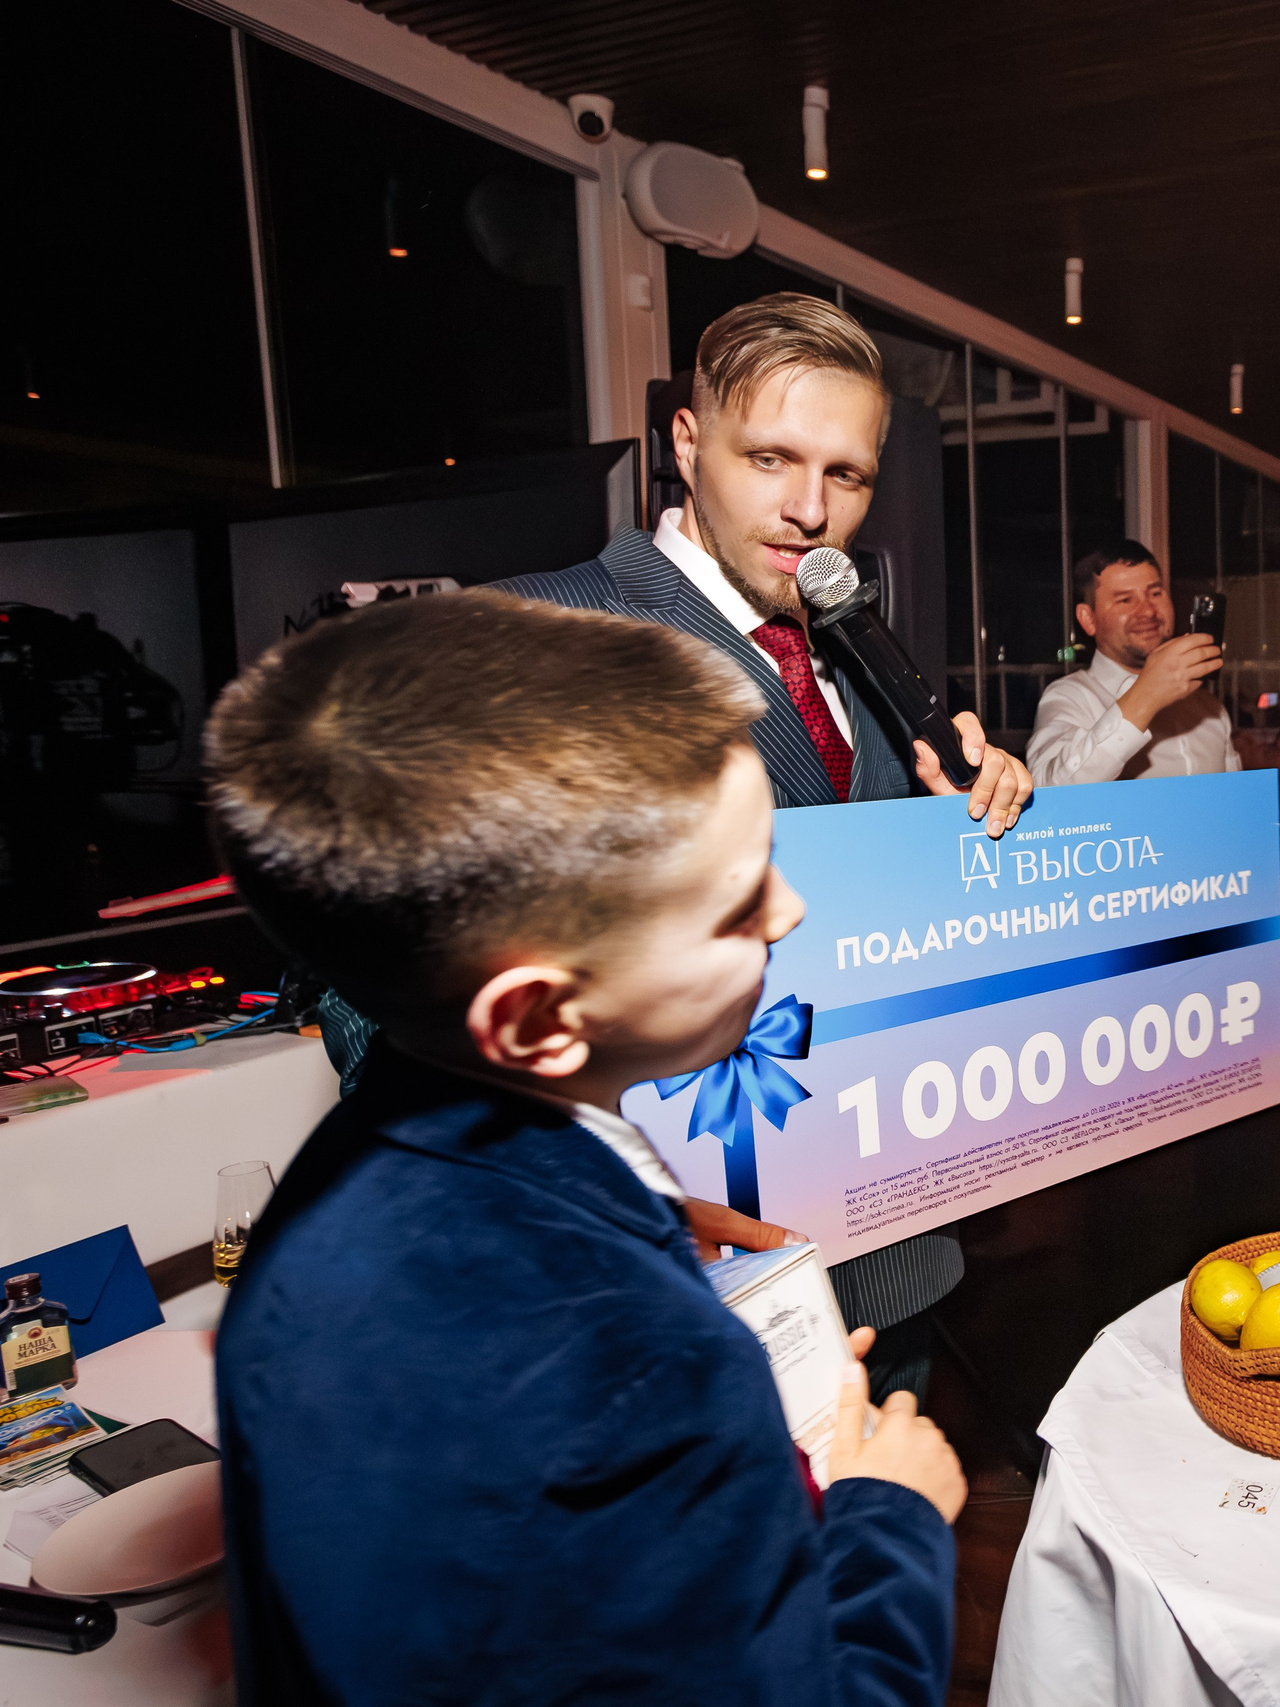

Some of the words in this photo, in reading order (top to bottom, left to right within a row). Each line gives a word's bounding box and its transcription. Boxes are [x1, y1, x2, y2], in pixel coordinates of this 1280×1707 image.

[1015, 826, 1055, 842] жилой
[1058, 822, 1112, 837] комплекс
[1008, 835, 1164, 885] ВЫСОТА
[836, 893, 1079, 970] ПОДАРОЧНЫЙ
[1088, 870, 1252, 921] СЕРТИФИКАТ
[837, 1075, 881, 1159] 1
[901, 1031, 1066, 1140] 000
[844, 1185, 867, 1197] Акции
[868, 1180, 878, 1188] не
[879, 1166, 923, 1185] суммируются.
[925, 1153, 961, 1169] Сертификат
[963, 1140, 1003, 1158] действителен
[1004, 1136, 1016, 1144] при
[1017, 1128, 1040, 1139] покупке
[1041, 1115, 1080, 1131] недвижимости
[845, 1196, 858, 1207] ЖК
[859, 1191, 880, 1202] «Сок»
[881, 1187, 889, 1195] от
[890, 1182, 899, 1192] 15
[899, 1180, 915, 1189] млн.
[916, 1172, 930, 1185] руб.
[931, 1154, 985, 1177] Первоначальный
[986, 1149, 1003, 1160] взнос
[1004, 1146, 1011, 1154] от
[1028, 1131, 1060, 1145] Сертификат
[845, 1204, 865, 1218] ООО
[869, 1198, 884, 1209] «СЗ
[887, 1184, 930, 1203] «ГРАНДЕКС»
[933, 1177, 945, 1188] ЖК
[947, 1169, 976, 1182] «Высота»
[1041, 1139, 1058, 1151] ООО
[1059, 1135, 1069, 1145] СЗ
[919, 1184, 961, 1202] Информация
[963, 1176, 981, 1187] носит
[984, 1163, 1018, 1181] рекламный
[1021, 1155, 1045, 1167] характер
[847, 1214, 905, 1238] индивидуальных
[906, 1199, 947, 1217] переговоров
[953, 1184, 992, 1200] покупателем.
[17, 1343, 57, 1360] МАРКА
[18, 1336, 54, 1352] НАША
[1238, 1484, 1264, 1509] 045
